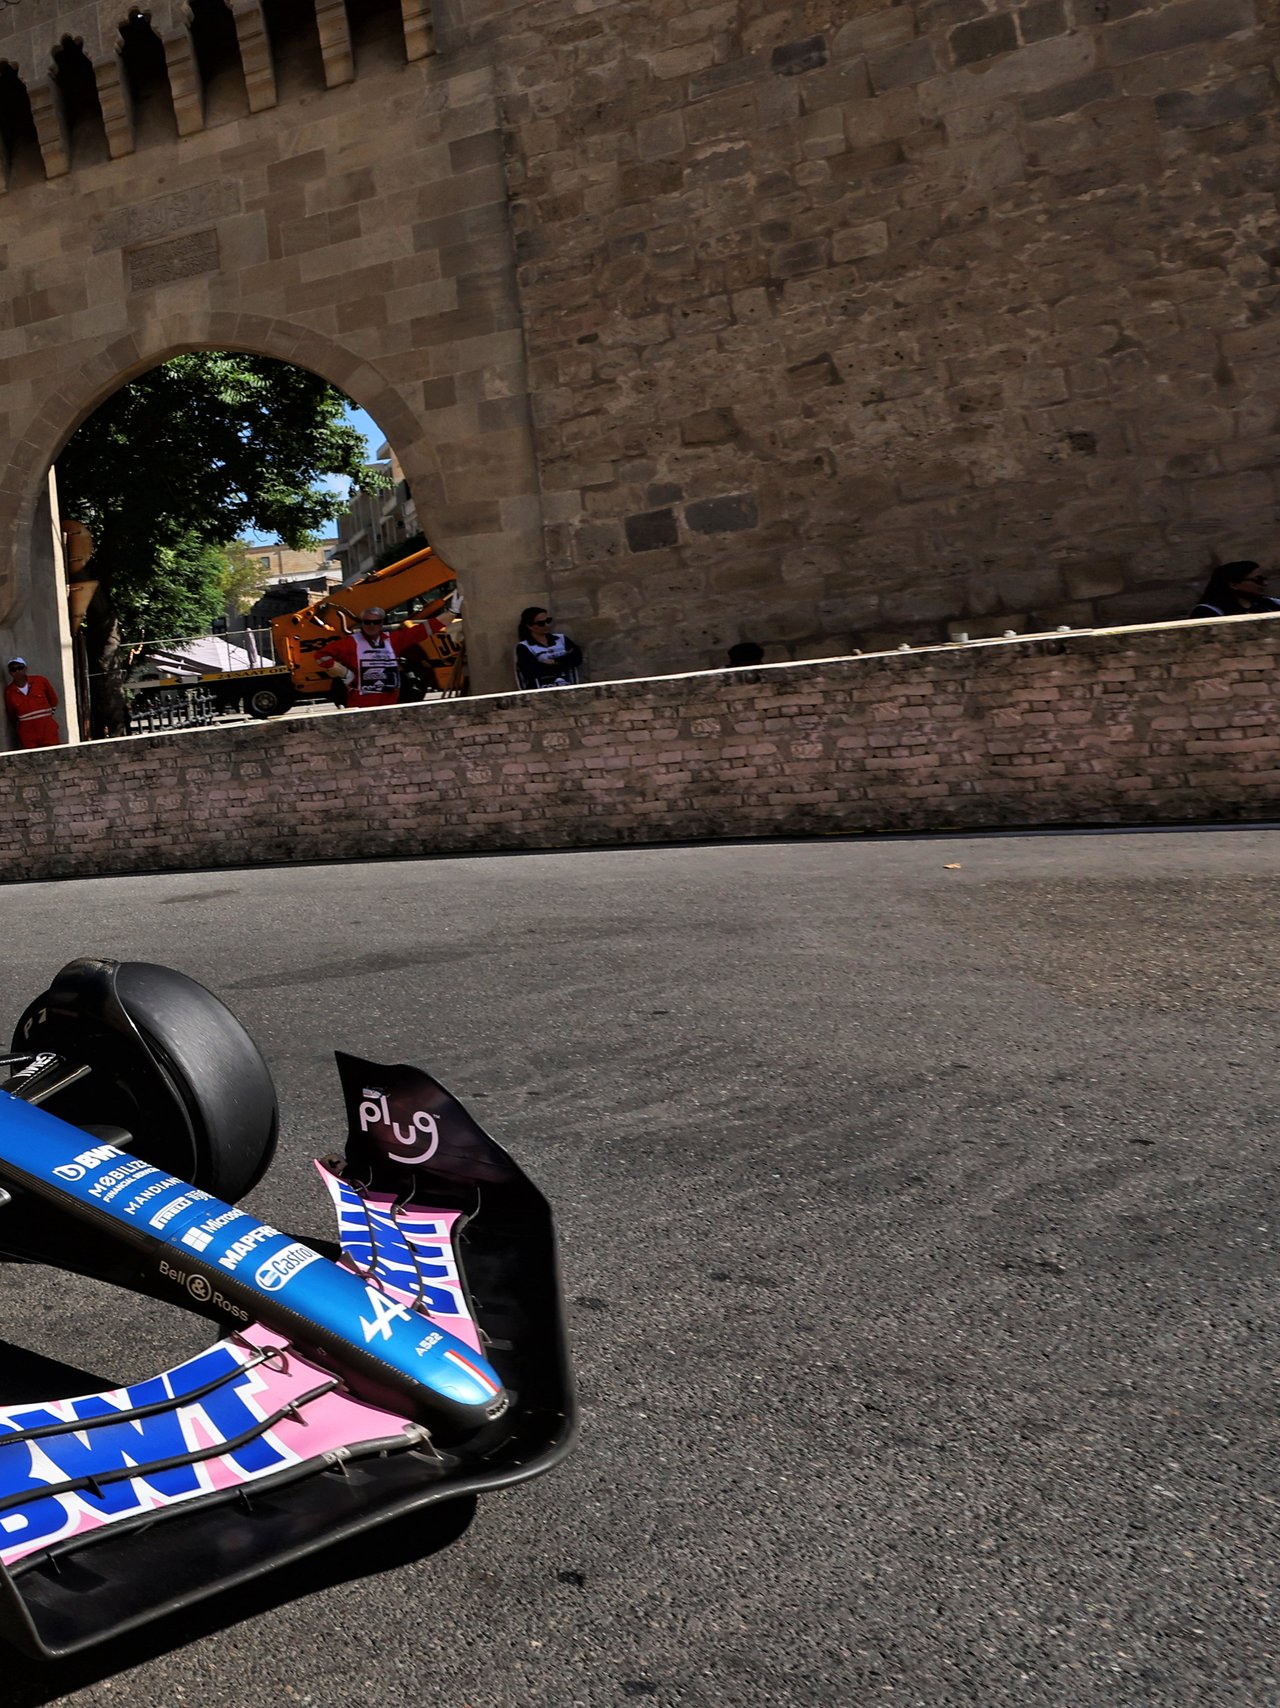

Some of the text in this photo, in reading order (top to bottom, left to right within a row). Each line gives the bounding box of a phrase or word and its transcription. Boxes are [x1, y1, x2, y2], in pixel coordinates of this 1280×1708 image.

[358, 1094, 440, 1164] plug
[102, 1174, 135, 1203] FINANCIAL
[148, 1195, 194, 1231] PIRELLI
[271, 1244, 318, 1277] Castrol
[159, 1260, 249, 1322] Bell & Ross
[414, 1330, 445, 1357] A522
